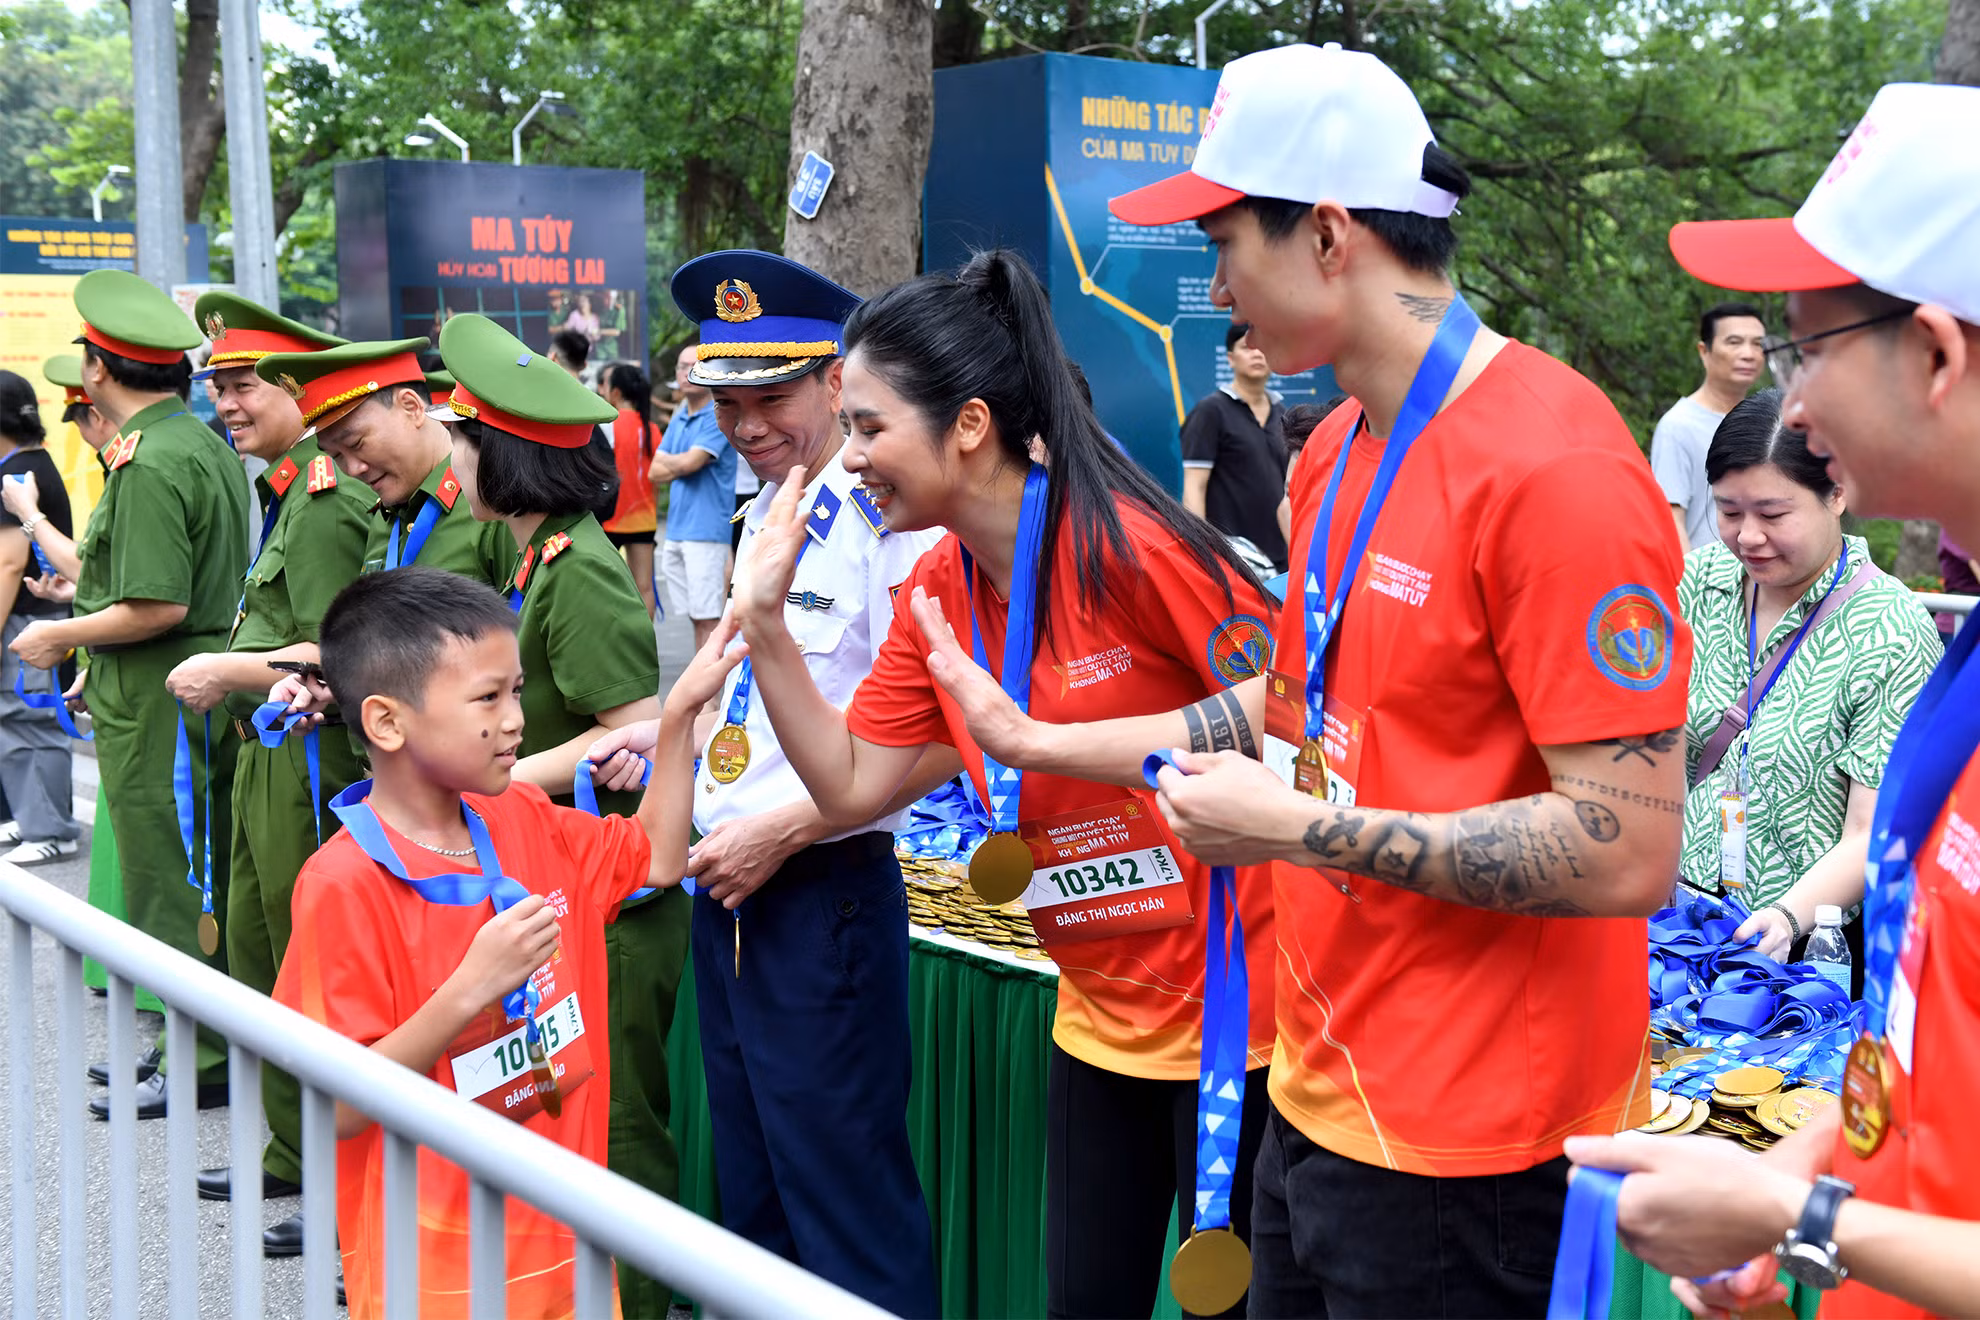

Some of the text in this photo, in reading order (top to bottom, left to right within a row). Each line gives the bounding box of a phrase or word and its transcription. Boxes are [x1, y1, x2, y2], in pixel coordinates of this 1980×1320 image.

[1082, 95, 1151, 131] NHỮNG
[1155, 100, 1193, 134] TÁC
[1081, 133, 1118, 160] CỦA
[1121, 140, 1145, 161] MA
[471, 214, 573, 253] MA TÚY
[498, 253, 570, 285] TƯƠNG
[575, 258, 605, 284] LAI
[1095, 667, 1114, 682] MA
[1087, 836, 1109, 851] MA
[1049, 858, 1144, 898] 10342
[1151, 848, 1175, 883] 1.7KM
[1055, 910, 1087, 927] ĐẶNG
[1087, 907, 1107, 921] THỊ
[1107, 901, 1138, 918] NGỌC
[504, 1083, 534, 1109] ĐẶNG
